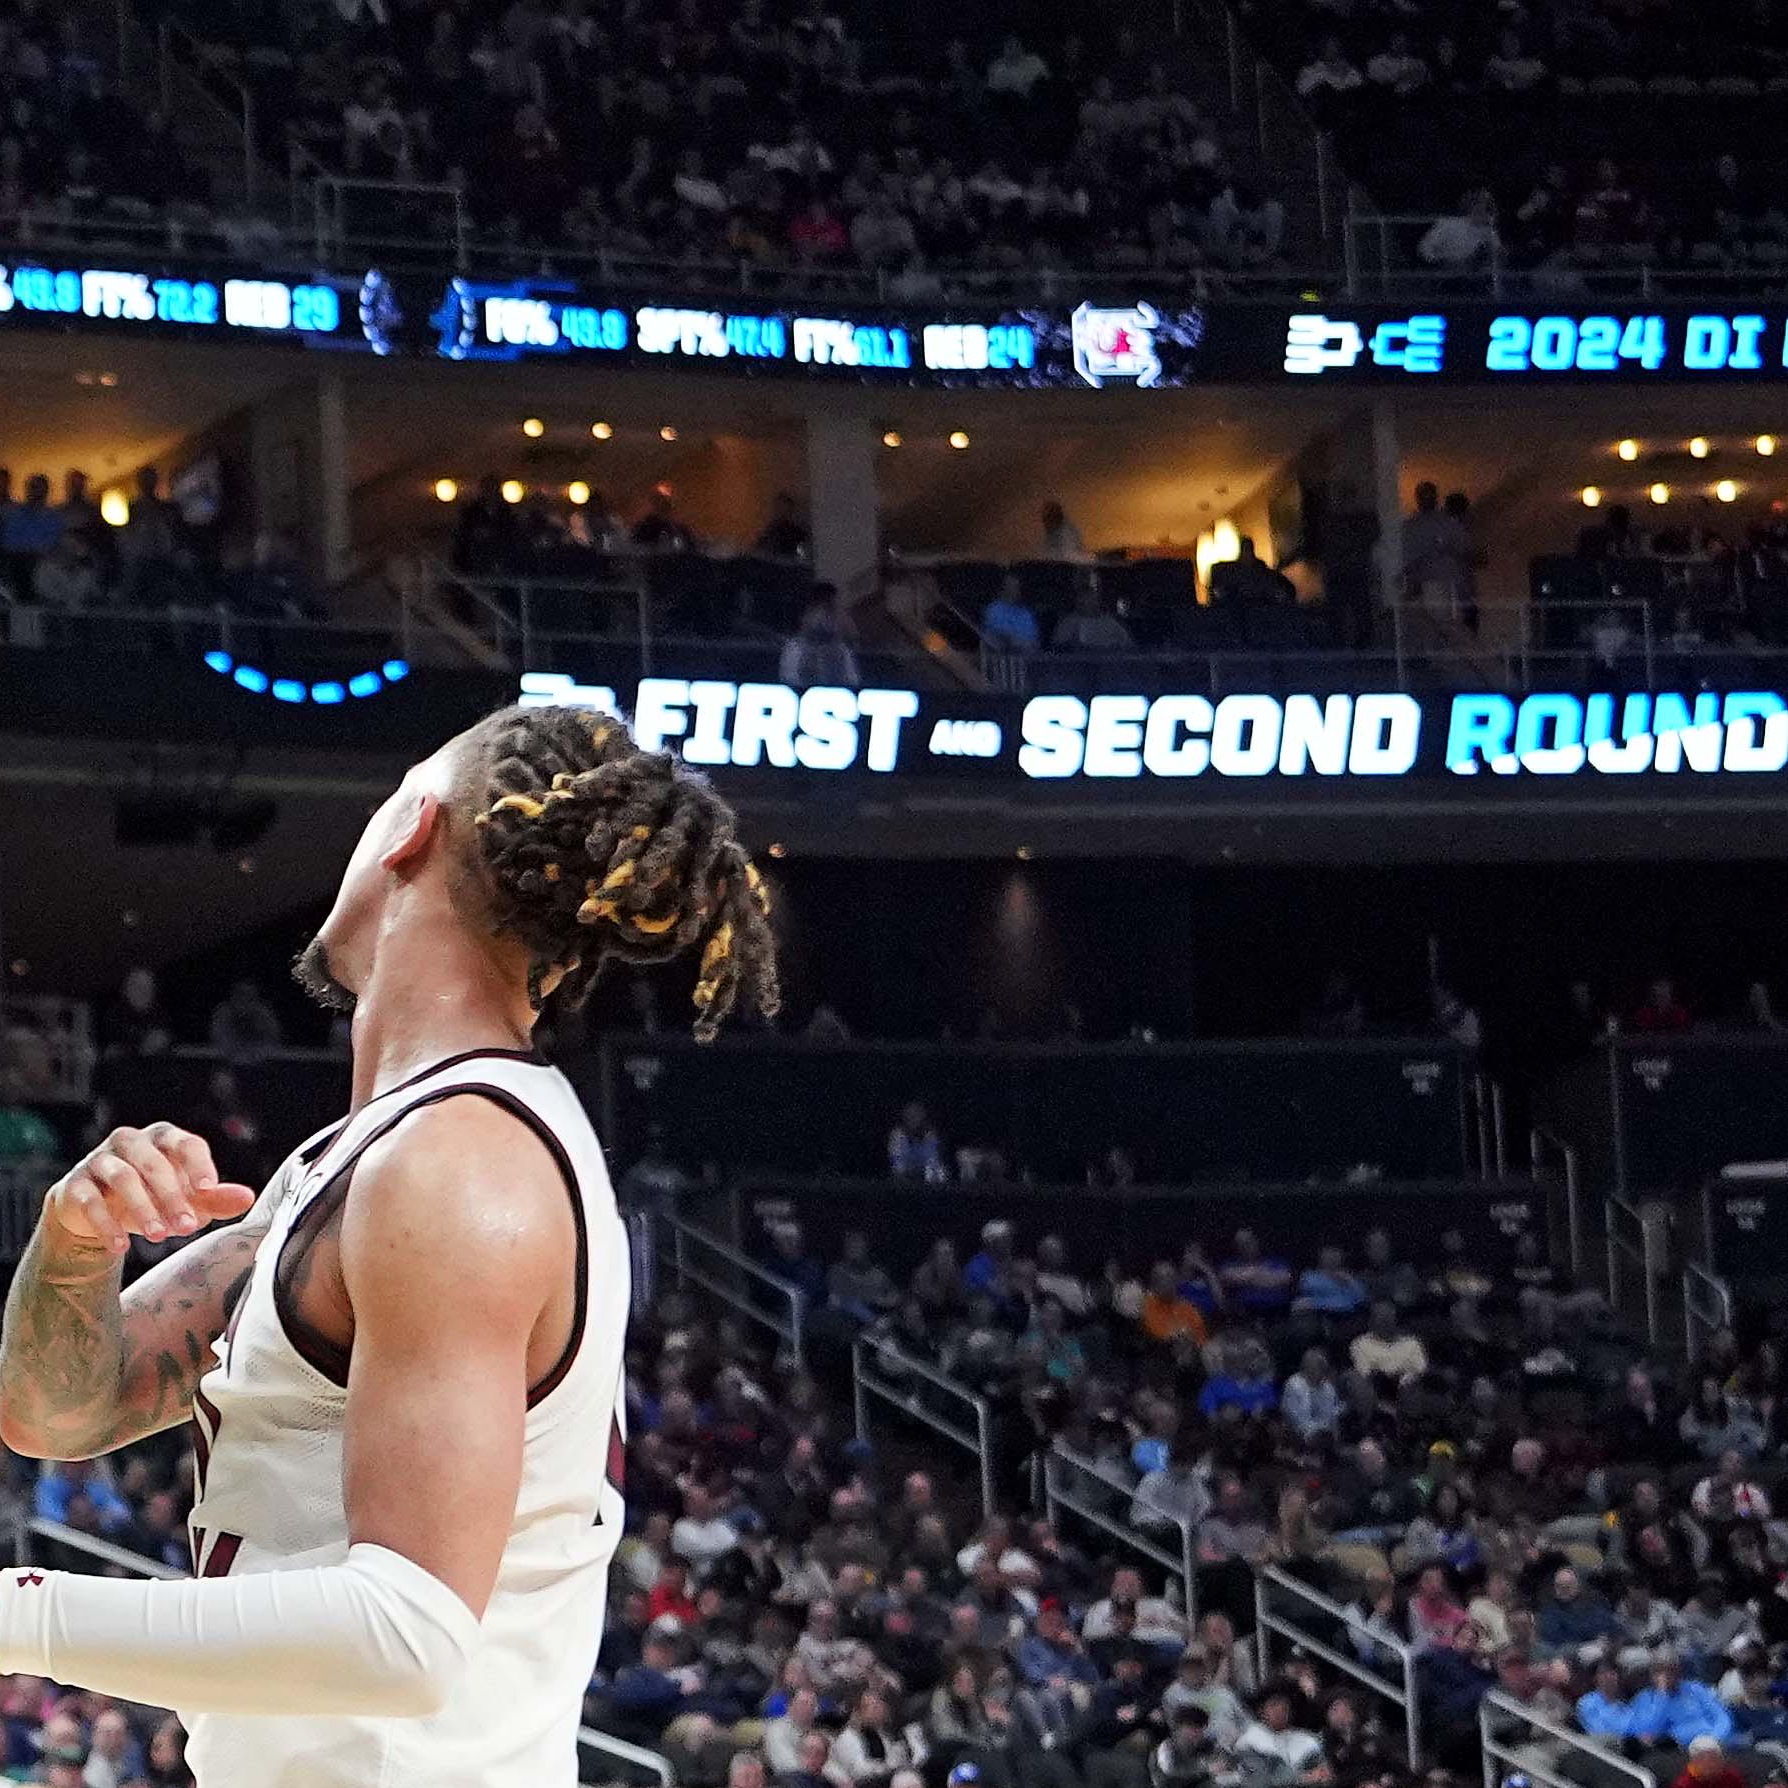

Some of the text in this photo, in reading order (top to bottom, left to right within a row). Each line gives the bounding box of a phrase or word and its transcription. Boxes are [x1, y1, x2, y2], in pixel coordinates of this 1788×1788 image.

[1486, 315, 1667, 371] 2024
[1683, 315, 1767, 370] DI
[635, 678, 919, 773] FIRST
[1018, 694, 1422, 778] SECOND
